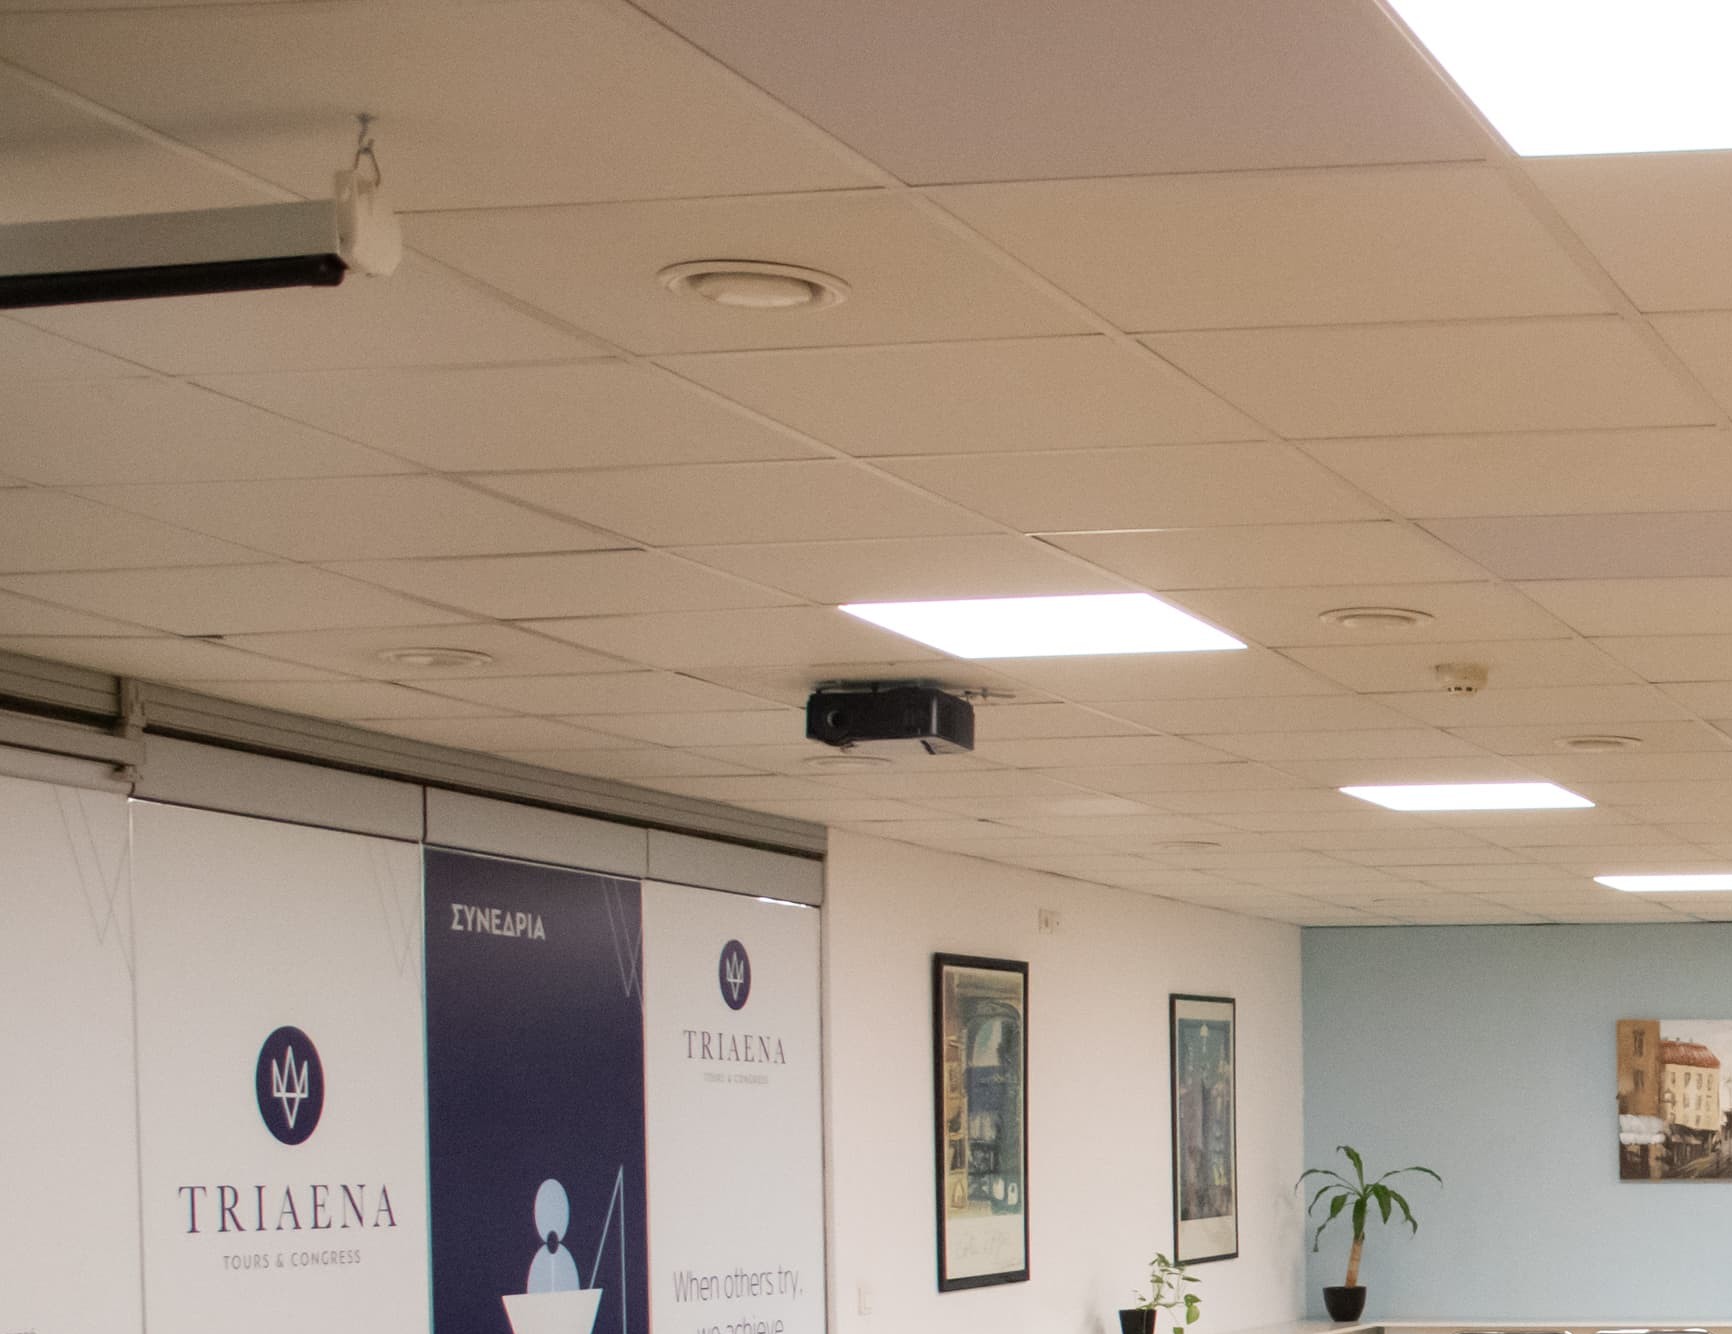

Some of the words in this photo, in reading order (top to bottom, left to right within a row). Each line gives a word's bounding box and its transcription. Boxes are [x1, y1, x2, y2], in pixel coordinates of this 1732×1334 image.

[451, 903, 546, 940] ΣΥΝΕΔΡΙΑ
[683, 1029, 786, 1065] TRIAENA
[178, 1184, 397, 1233] TRIAENA
[223, 1254, 270, 1270] TOURS
[276, 1254, 285, 1268] &
[290, 1250, 361, 1267] CONGRESS
[673, 1271, 720, 1303] When
[724, 1267, 774, 1299] others
